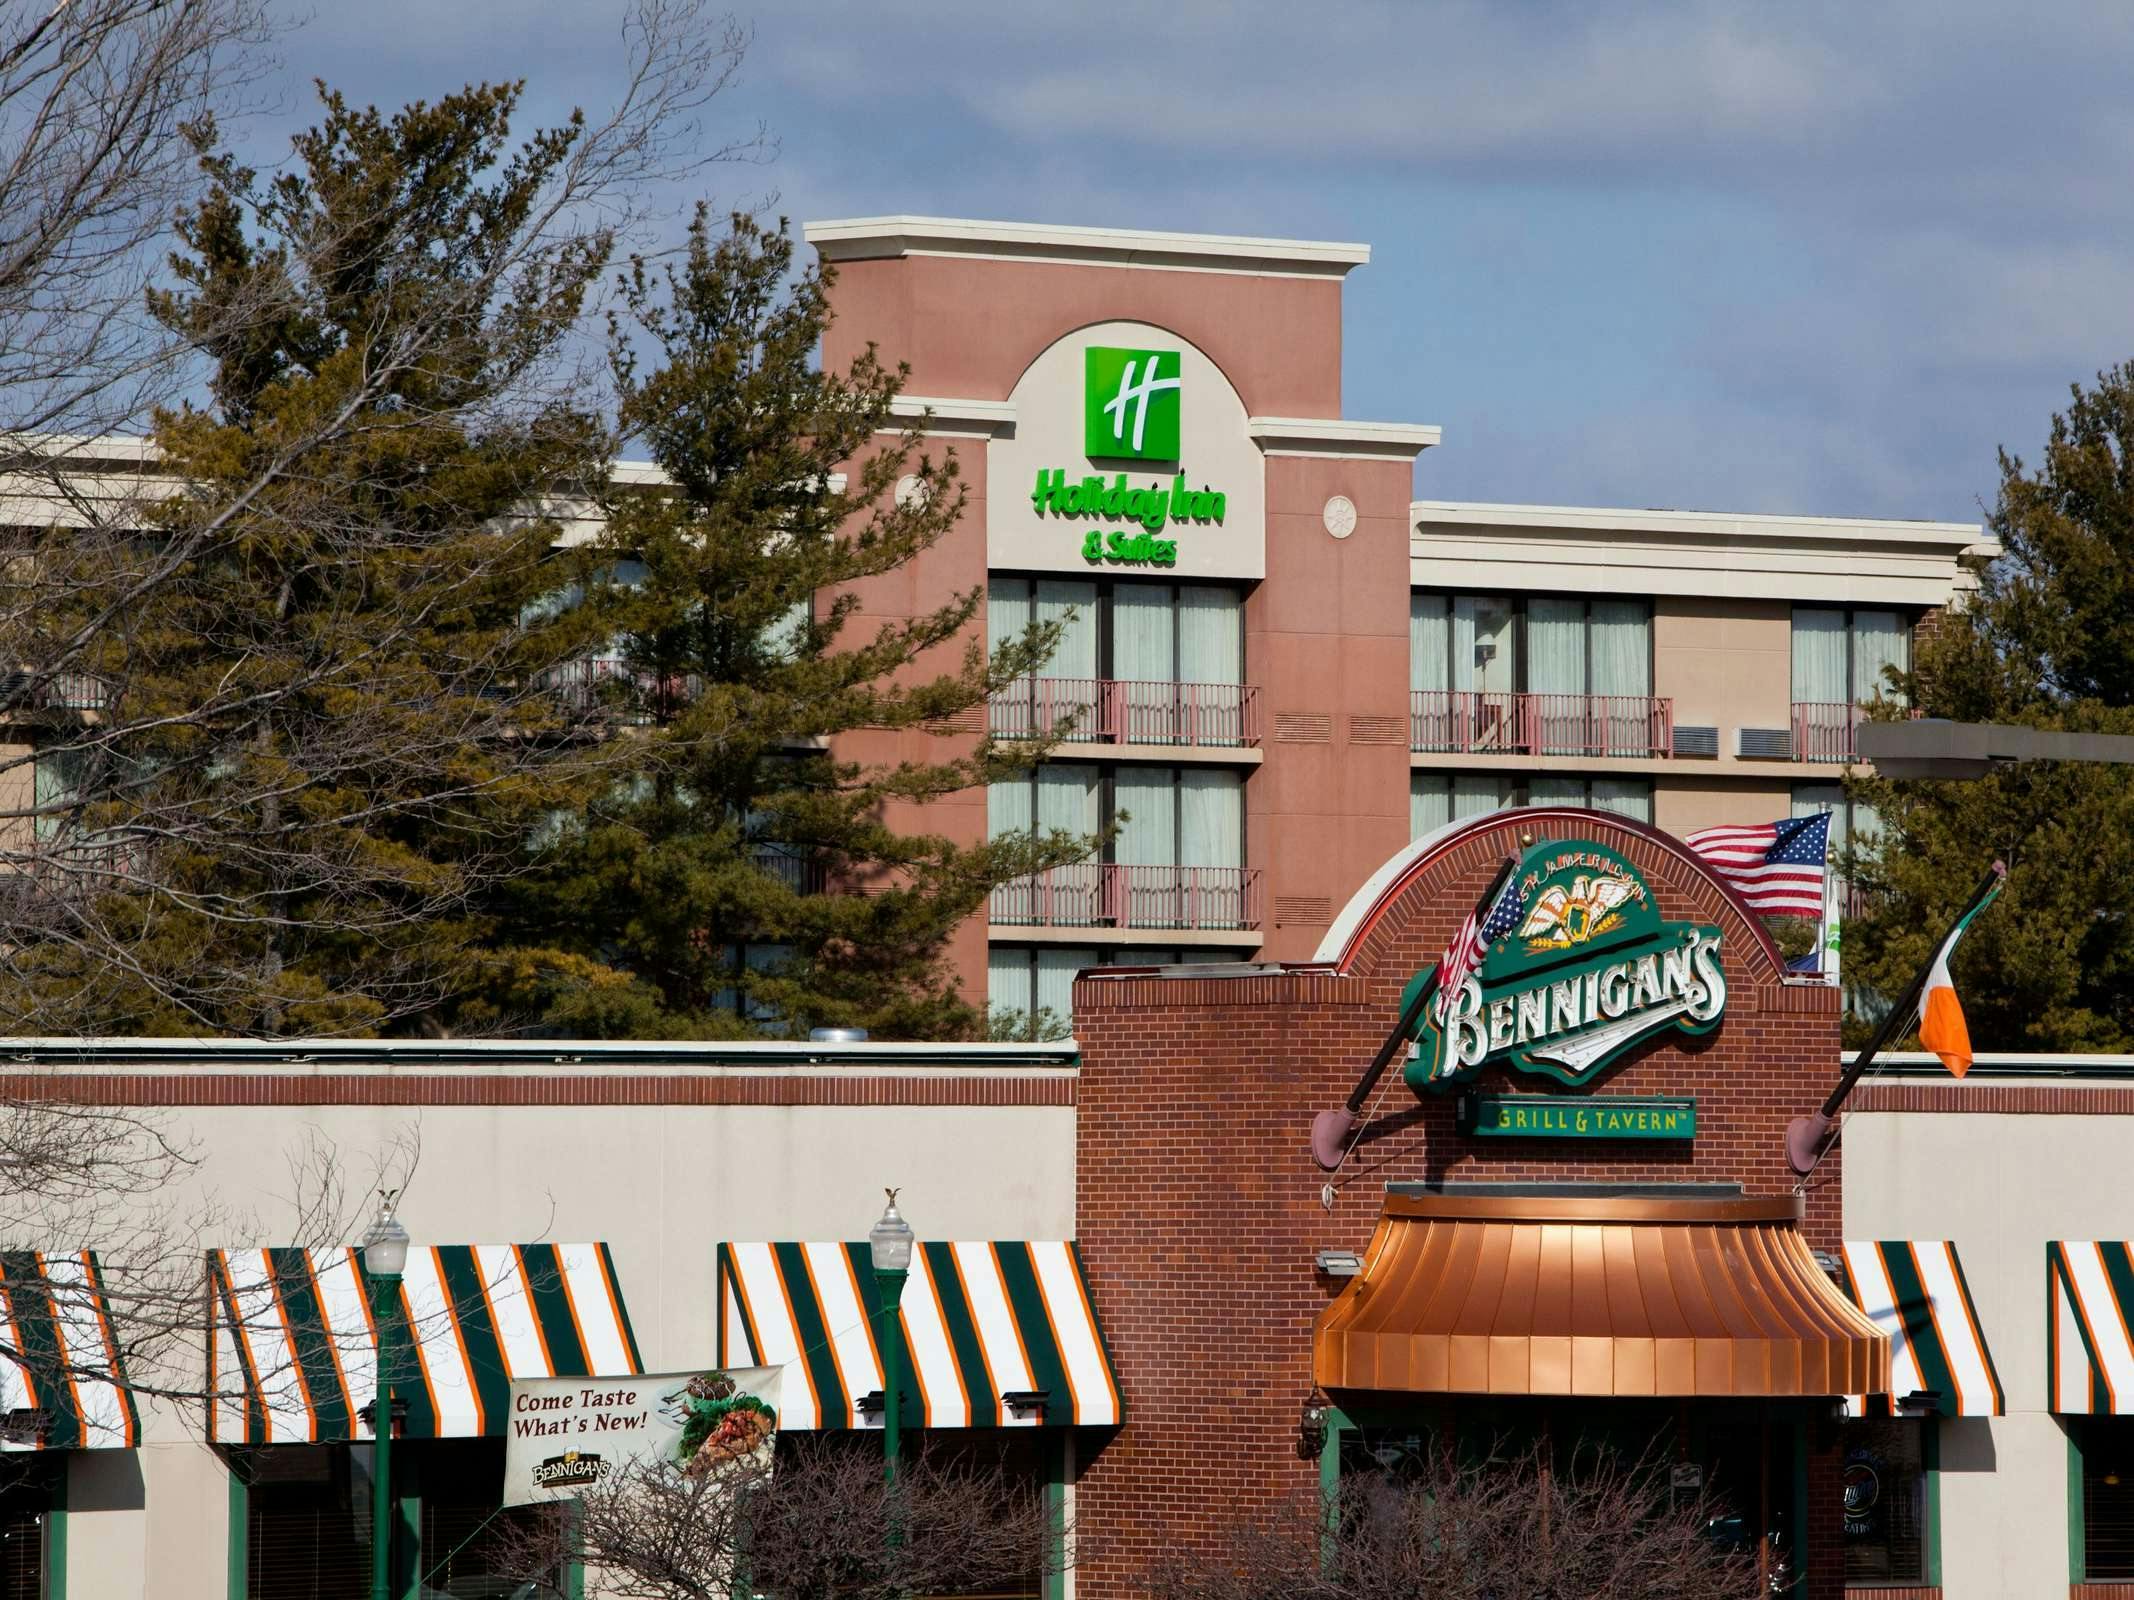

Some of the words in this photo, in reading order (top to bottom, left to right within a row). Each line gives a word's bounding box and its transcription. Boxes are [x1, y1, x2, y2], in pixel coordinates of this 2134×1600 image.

[1031, 468, 1169, 528] Holiday
[1169, 474, 1226, 521] Inn
[1081, 529, 1104, 560] &
[1106, 531, 1177, 562] Suites
[1434, 927, 1727, 1078] BENNIGAN'S
[1499, 1109, 1568, 1129] GRILL
[1576, 1110, 1588, 1132] &
[1595, 1111, 1677, 1131] TAVERN
[516, 1393, 573, 1413] Come
[580, 1389, 637, 1408] Taste
[514, 1415, 588, 1439] What's
[594, 1411, 648, 1432] New!
[533, 1460, 611, 1486] BENNIGAN'S
